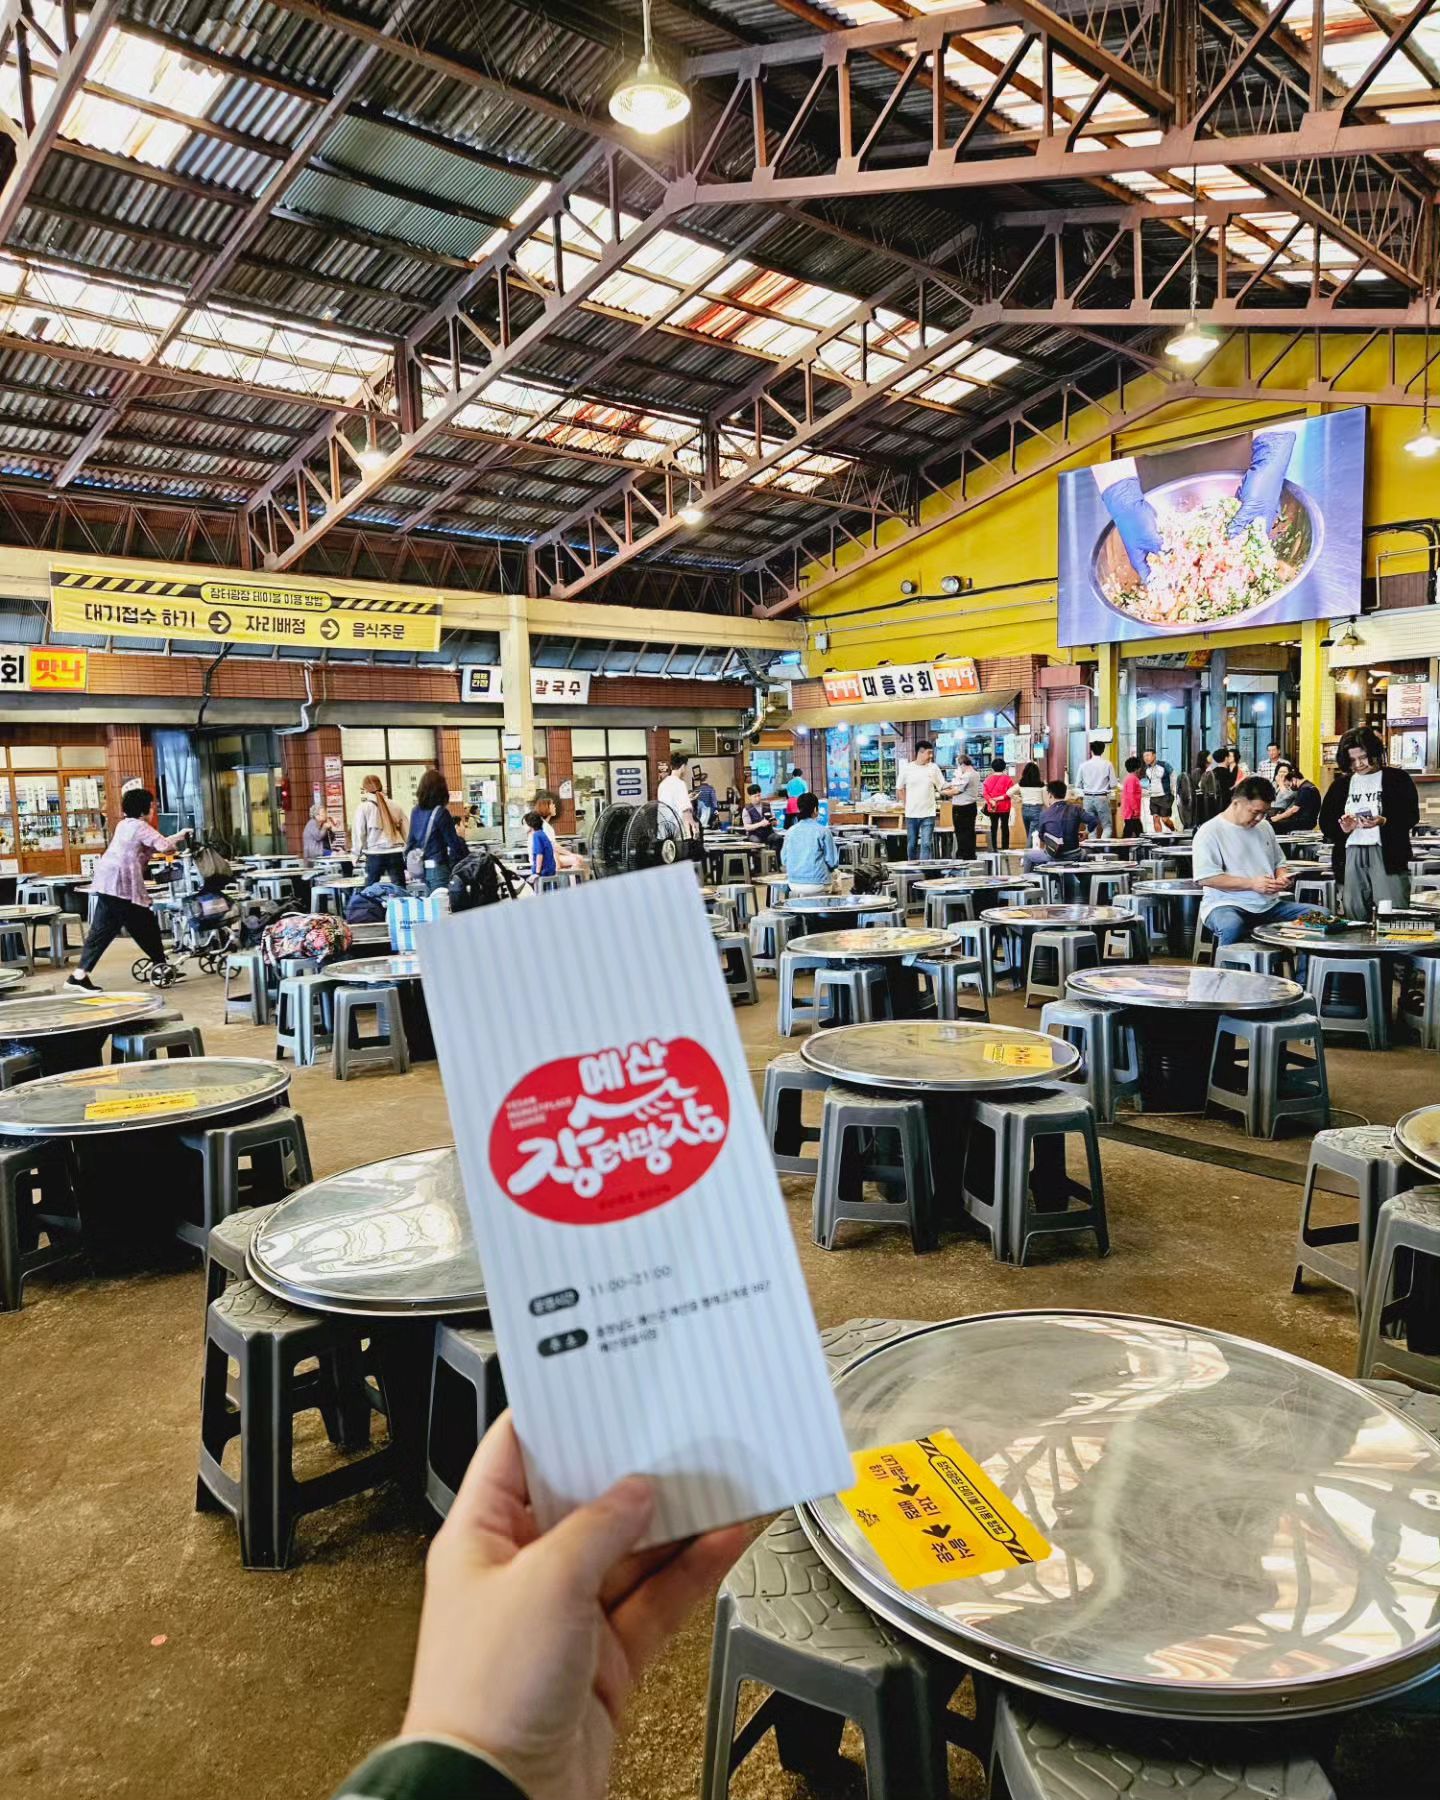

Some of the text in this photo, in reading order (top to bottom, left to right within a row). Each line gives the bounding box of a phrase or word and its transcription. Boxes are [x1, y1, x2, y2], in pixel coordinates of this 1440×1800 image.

[253, 591, 281, 604] 테이블
[284, 593, 302, 606] 이용
[305, 595, 323, 607] 방법
[84, 603, 405, 640] 대기접수 하기 자리배정 음식주문
[1, 655, 24, 683] 회
[535, 679, 581, 696] 칼국수
[861, 670, 934, 697] 대흥상회
[578, 1039, 669, 1095] 예산
[507, 1097, 725, 1198] 장터광장
[868, 1464, 890, 1480] 하기
[880, 1454, 910, 1483] 대기접수
[898, 1499, 922, 1520] 배정
[916, 1496, 942, 1516] 자리
[931, 1542, 955, 1564] 주문
[948, 1538, 977, 1559] 음식
